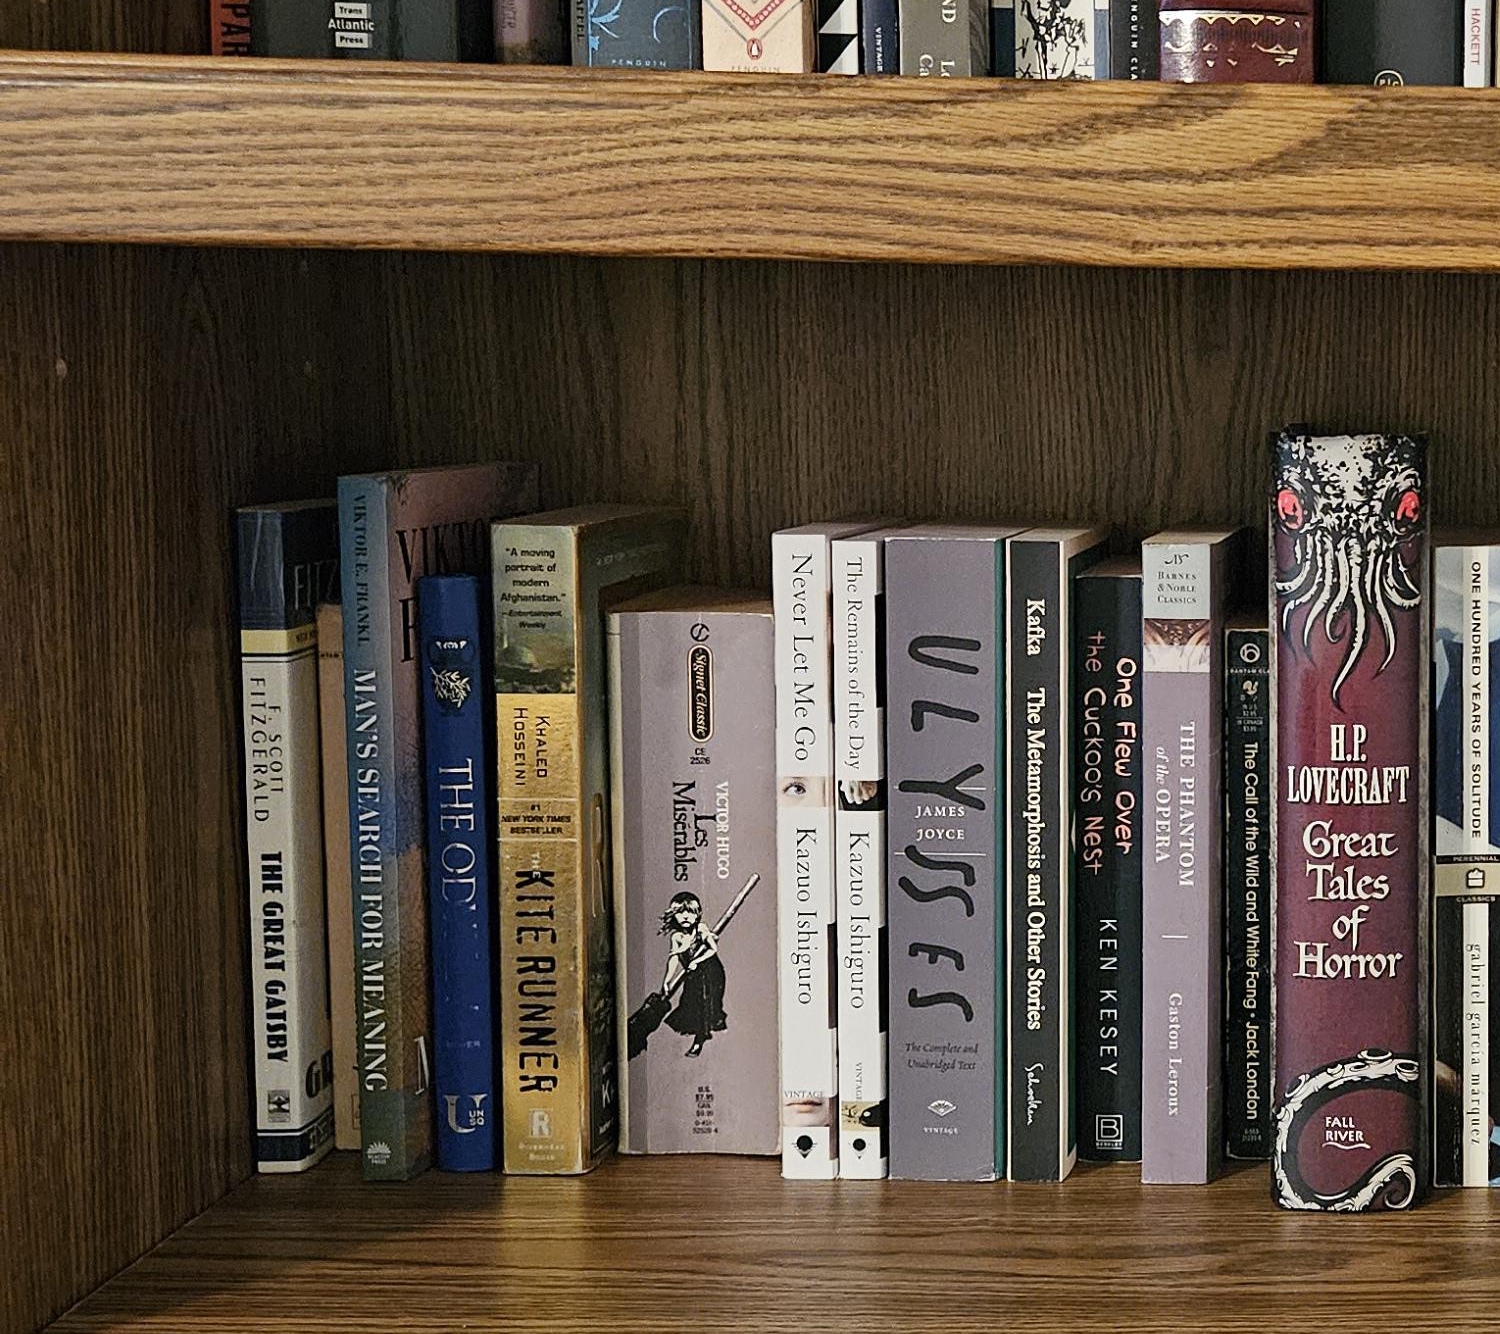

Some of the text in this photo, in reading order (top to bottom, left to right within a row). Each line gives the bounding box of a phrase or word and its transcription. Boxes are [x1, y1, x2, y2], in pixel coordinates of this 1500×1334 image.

[328, 19, 375, 31] Atlantic
[1470, 8, 1481, 65] HACKETT
[1471, 561, 1482, 839] ONE HUNDRED YEARS OF SOLITUDE
[250, 677, 269, 823] FITZGERALD
[1330, 723, 1367, 762] H.P.
[789, 554, 818, 1005] Never Let Me Go Kazuo Ishiguro
[1287, 765, 1410, 805] LOVECRAFT
[670, 780, 699, 882] Misérables
[693, 813, 717, 847] Les
[1021, 599, 1046, 1030] Kafka The Metamorphosis and Other Stories
[1302, 820, 1399, 859] Great
[1306, 864, 1390, 902] Tales
[1332, 905, 1370, 951] of
[259, 851, 289, 1063] THE GREAT GATSBY
[1293, 941, 1402, 980] Horror
[513, 870, 559, 1094] KITE RUNNER
[1098, 919, 1119, 1076] KEN KESEY
[1325, 1116, 1355, 1129] FALL
[1325, 1130, 1364, 1142] RIVER
